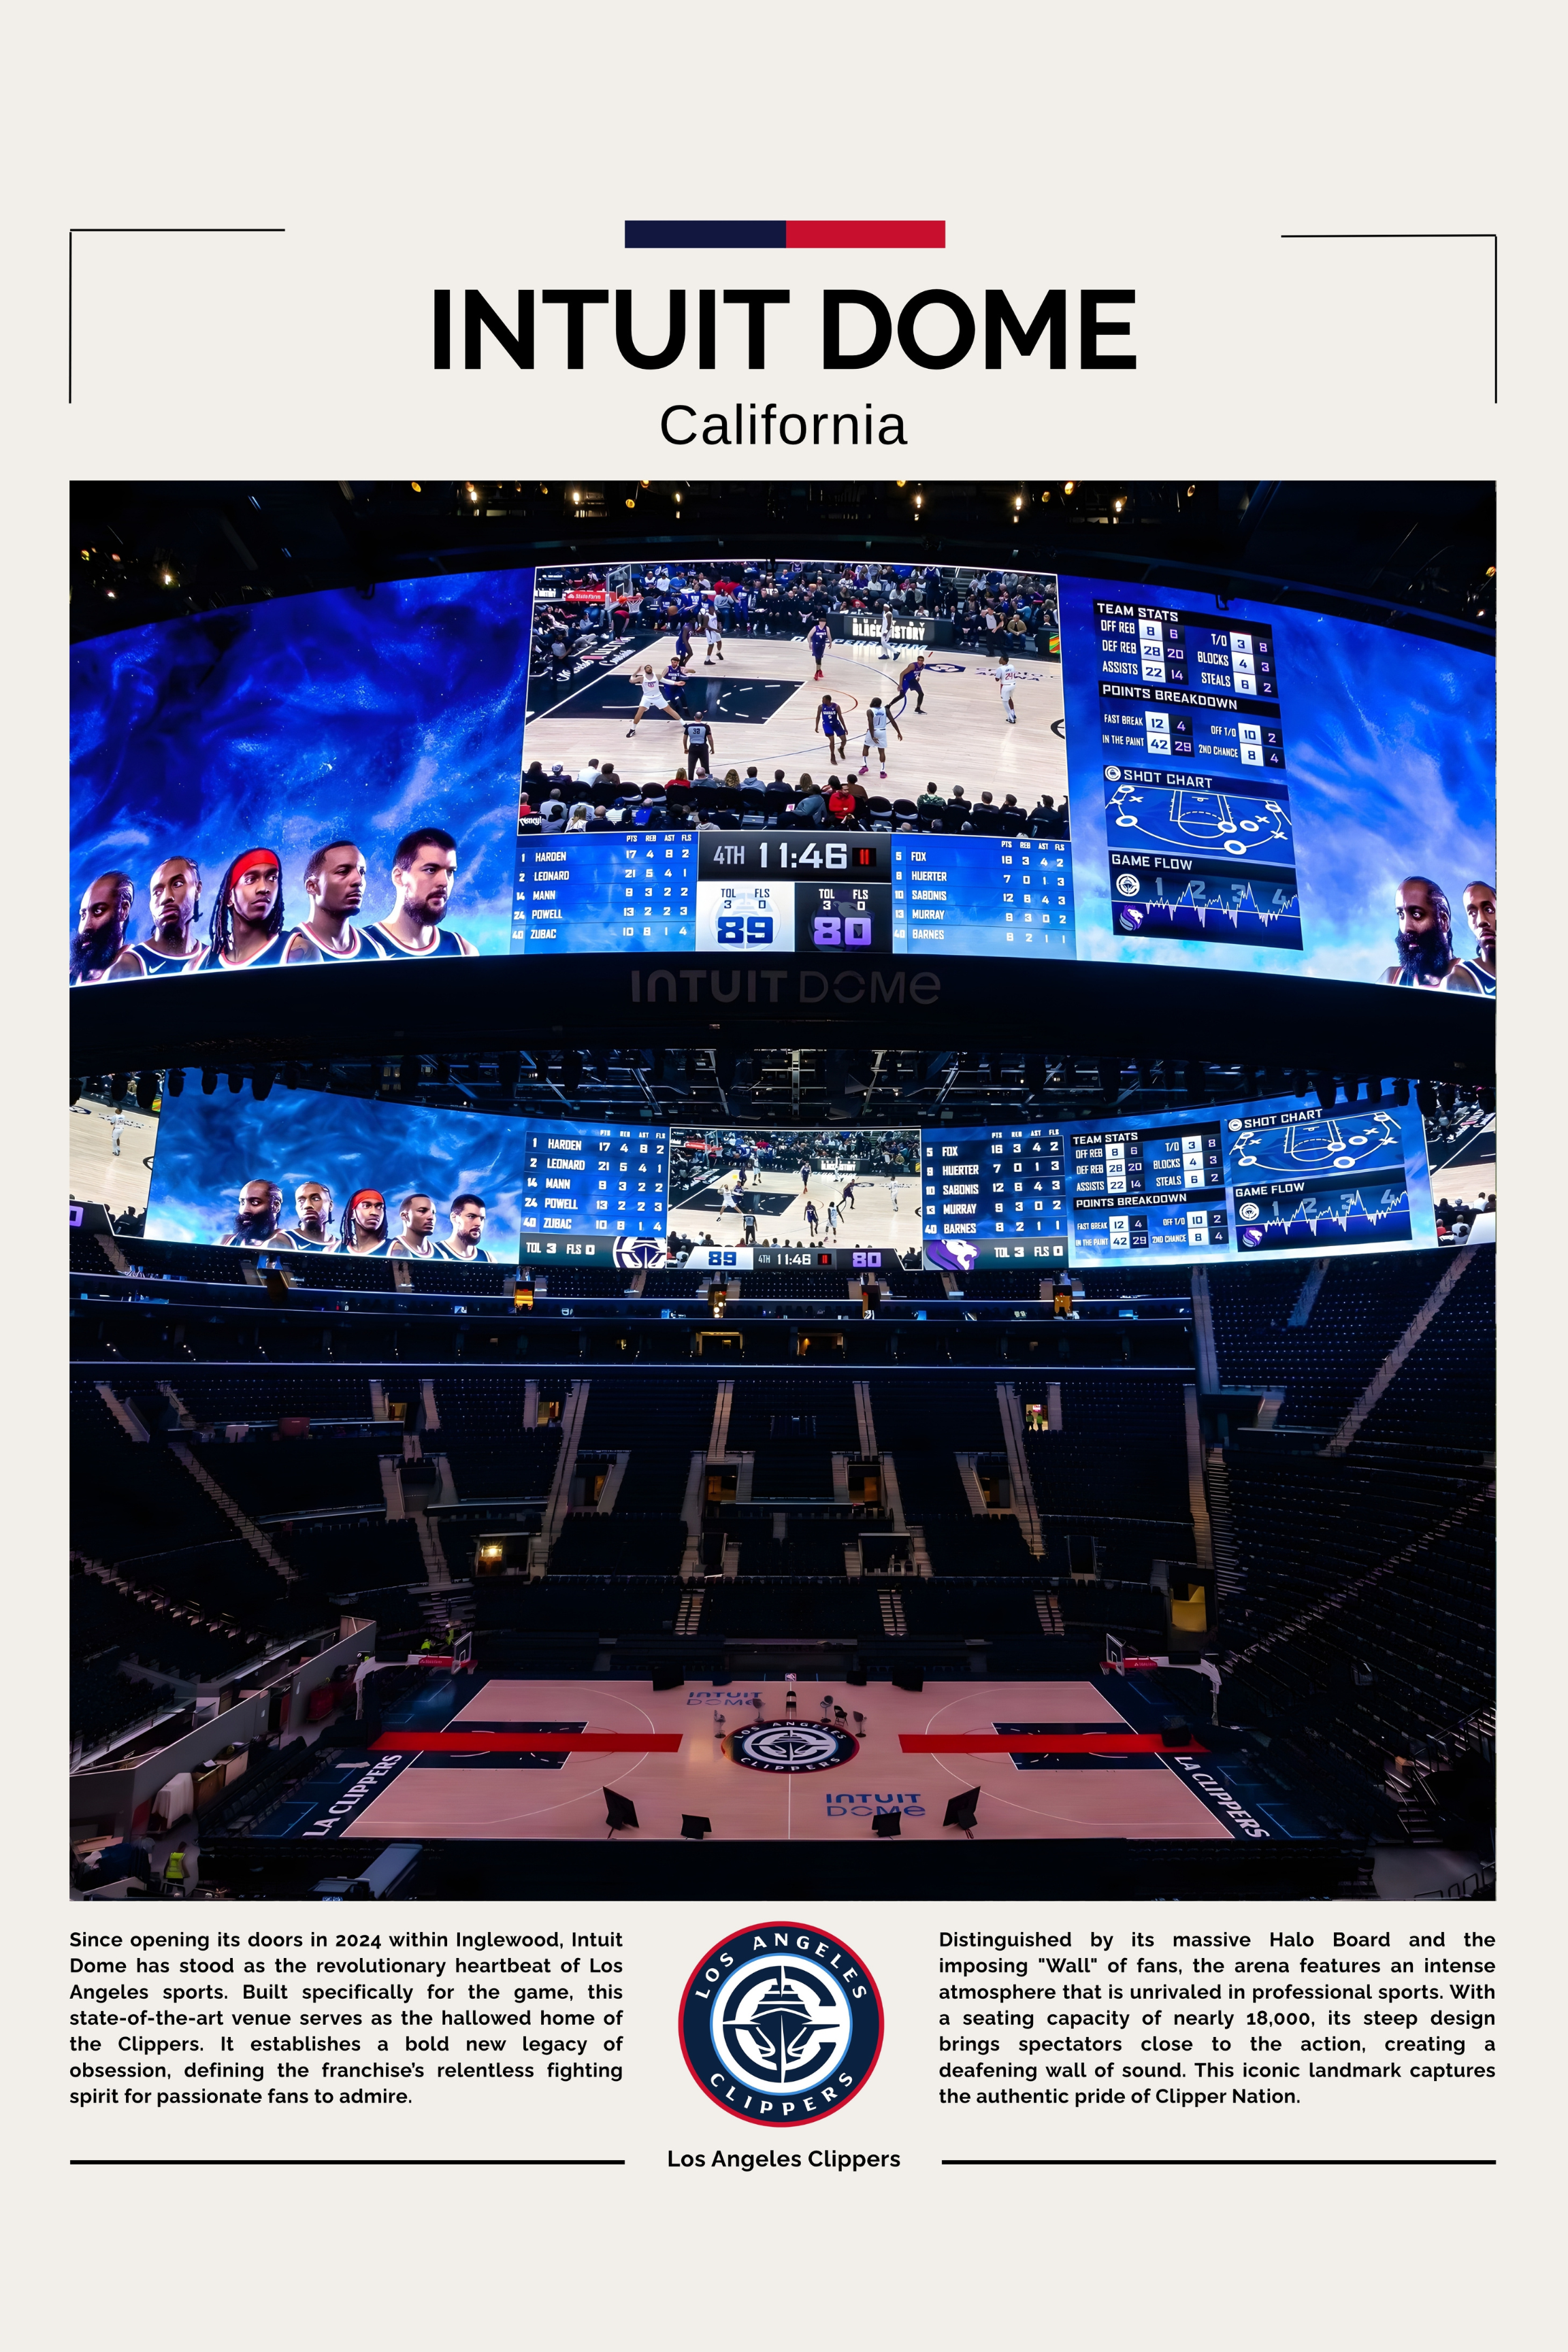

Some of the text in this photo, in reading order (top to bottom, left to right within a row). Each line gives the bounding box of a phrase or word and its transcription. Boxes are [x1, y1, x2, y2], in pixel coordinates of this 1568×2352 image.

[1097, 603, 1178, 622] TEAM STATS
[853, 622, 882, 637] BLACK
[889, 625, 925, 640] ISTORY
[1101, 620, 1135, 634] OFF REB
[1211, 634, 1227, 647] T/O
[1102, 640, 1183, 659] DEF REB 28 20
[1198, 651, 1229, 666] BLOCKS
[1102, 661, 1183, 680] ASSISTS 22 14
[1201, 672, 1230, 687] STEALS
[1102, 685, 1237, 710] POINTS BREAKDOWN
[1104, 714, 1164, 728] FAST BREAK 12
[1211, 725, 1256, 740] OFF T/O 10
[1102, 734, 1191, 752] IN THE PAINT 42 29
[1198, 745, 1239, 758] 2ND CHANCE
[1124, 769, 1213, 789] SHOT CHART
[536, 851, 566, 862] HARDEN
[713, 843, 847, 869] 4TH 11:46
[911, 851, 926, 862] FOX
[1111, 854, 1193, 871] GAME FLOW
[534, 871, 570, 881] LEONARD
[911, 871, 947, 882] HUERTER
[533, 890, 555, 900] MANN
[721, 888, 770, 898] TOL FLS
[819, 889, 868, 900] TOL FLS
[912, 890, 947, 901] SABONIS
[724, 900, 766, 909] 3 0
[823, 900, 866, 911] 3 0
[532, 909, 563, 919] POWELL
[912, 909, 945, 920] MURRAY
[530, 929, 557, 939] ZUBAC
[717, 916, 773, 944] 89
[813, 917, 872, 945] 80
[912, 929, 945, 940] BARNES
[1244, 1109, 1323, 1130] SHOT CHART
[548, 1139, 582, 1151] HARDEN
[1073, 1132, 1138, 1145] TEAM STATS
[942, 1146, 958, 1157] FOX
[1076, 1148, 1103, 1159] OFF REB
[1165, 1142, 1179, 1152] T/O
[546, 1158, 585, 1171] LEONARD
[943, 1164, 979, 1176] HUERTER
[1077, 1164, 1104, 1175] DEF REB
[1154, 1158, 1181, 1170] BLOCKS
[546, 1178, 571, 1190] MANN
[1077, 1181, 1105, 1192] ASSISTS
[1156, 1175, 1181, 1187] STEALS
[943, 1183, 979, 1196] SABONIS
[1235, 1182, 1305, 1198] GAME FLOW
[544, 1198, 578, 1210] POWELL
[1077, 1193, 1187, 1208] POINTS BREAKDOWN
[943, 1203, 977, 1215] MURRAY
[543, 1218, 572, 1229] ZUBAC
[943, 1223, 977, 1235] BARNES
[708, 1251, 881, 1267] 89 4TH 11:46 80
[734, 1722, 847, 1740] LOS ANGELES
[740, 1757, 840, 1771] CLIPPERS
[302, 1754, 402, 1836] LA CLIPPERS
[1174, 1757, 1271, 1838] LA CLIPPERS
